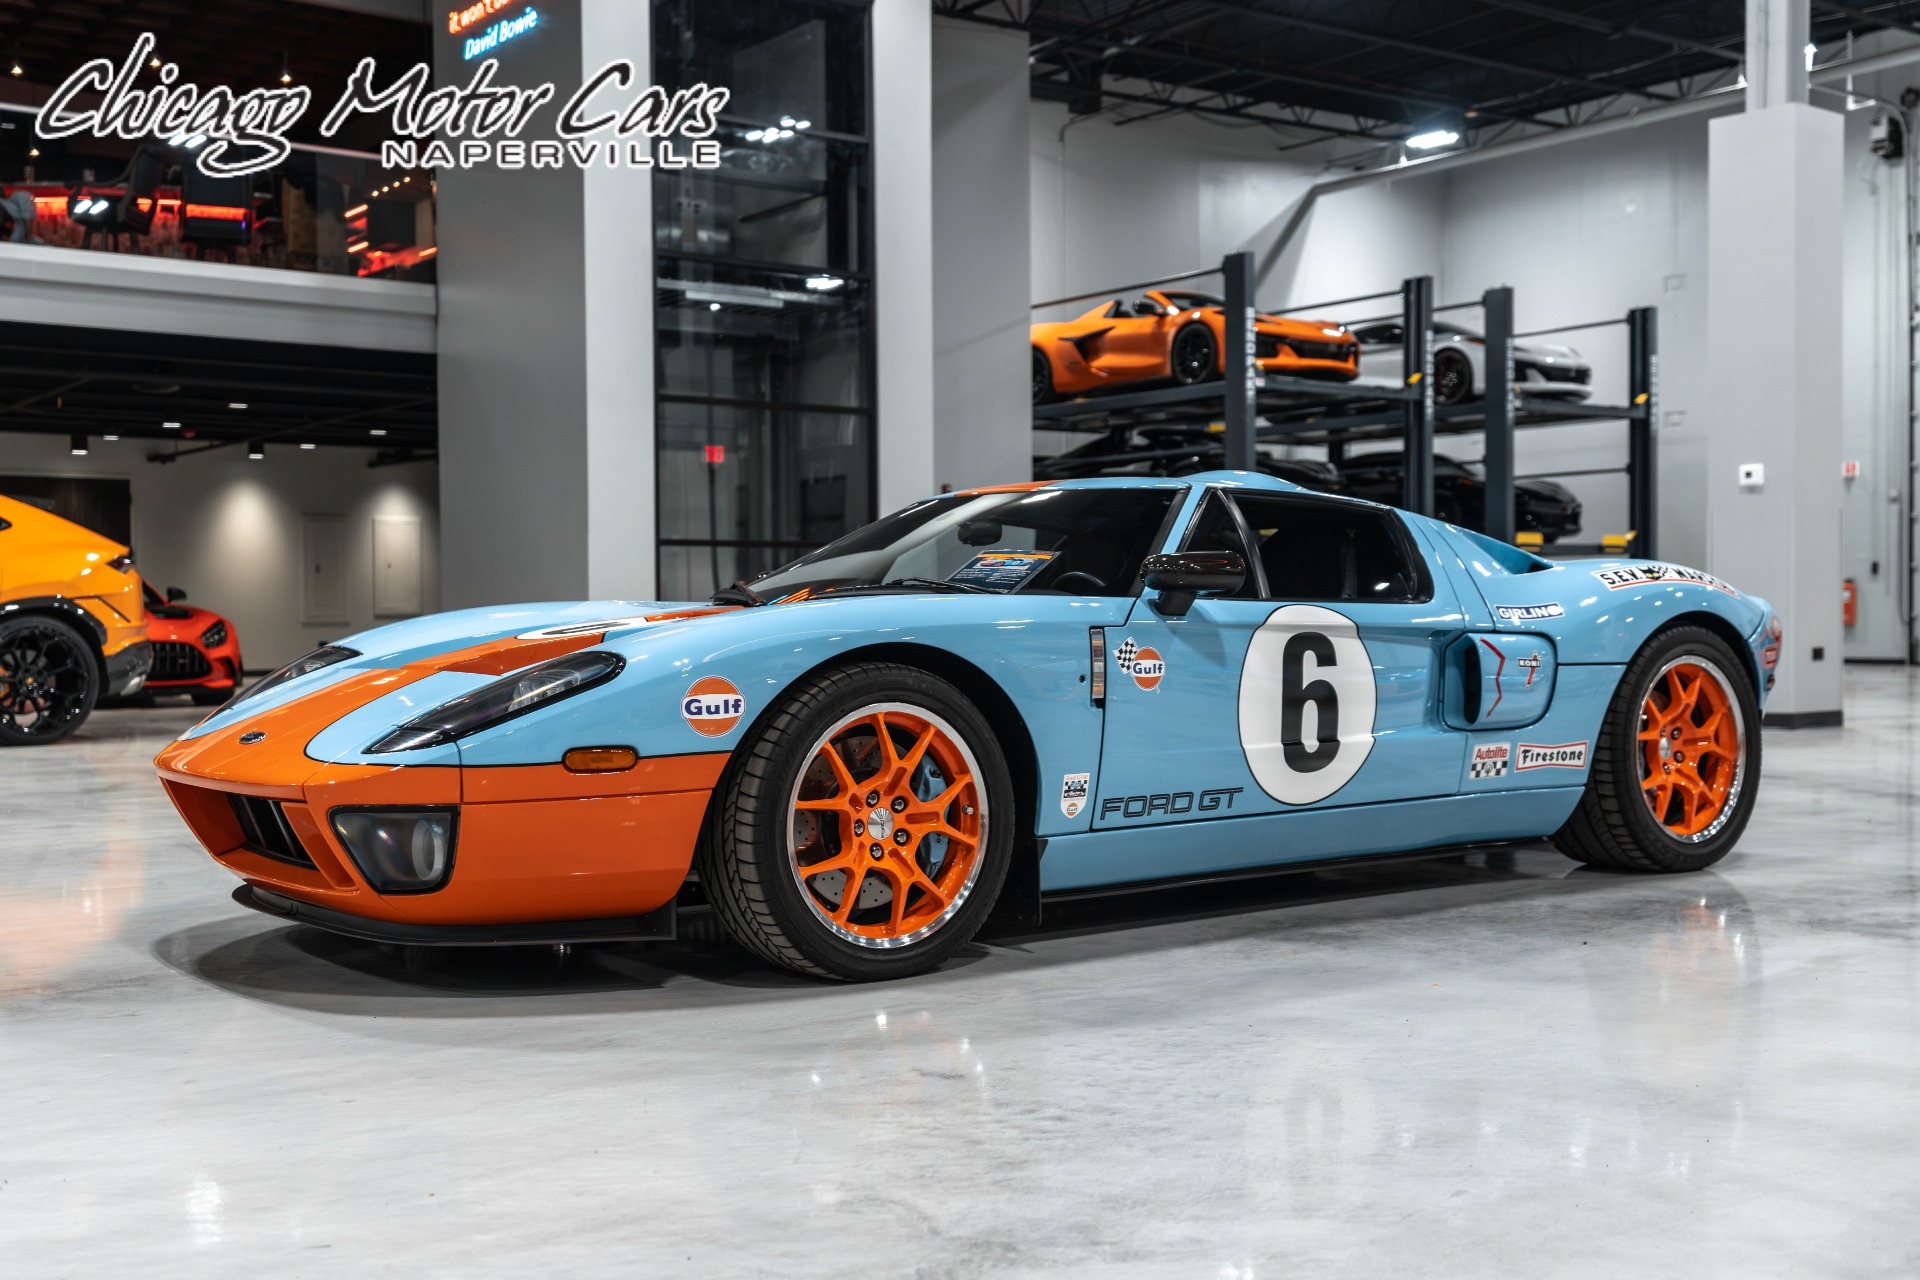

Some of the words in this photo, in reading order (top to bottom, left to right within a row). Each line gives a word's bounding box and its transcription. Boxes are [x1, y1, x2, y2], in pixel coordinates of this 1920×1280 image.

[464, 24, 499, 60] David
[499, 6, 538, 43] Bowie
[1600, 567, 1643, 586] S.E.V.
[1498, 605, 1562, 619] GIRLIN
[1132, 662, 1163, 675] Gulf
[1519, 659, 1541, 667] KONI
[684, 698, 742, 716] Gulf
[1280, 631, 1341, 774] 6
[1475, 746, 1508, 760] Autolite
[1521, 748, 1584, 765] Firestone
[1099, 791, 1195, 821] FORD
[1198, 787, 1244, 811] GT
